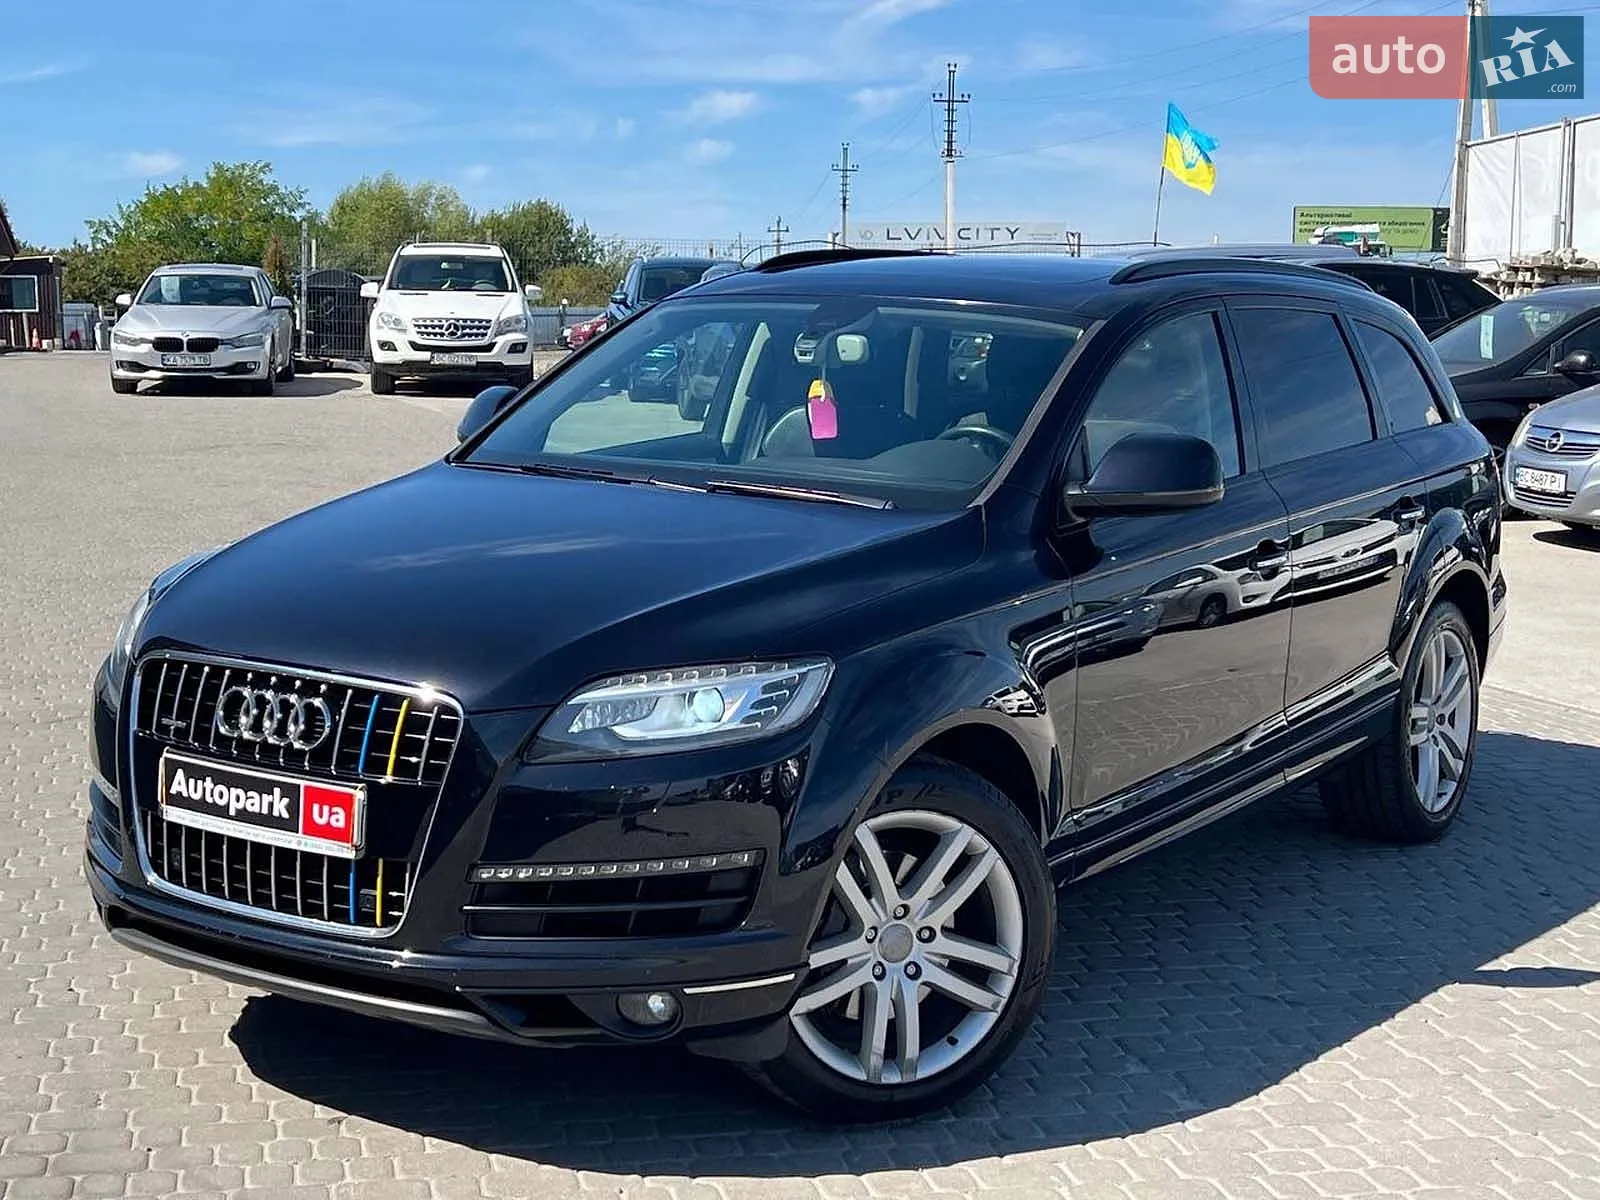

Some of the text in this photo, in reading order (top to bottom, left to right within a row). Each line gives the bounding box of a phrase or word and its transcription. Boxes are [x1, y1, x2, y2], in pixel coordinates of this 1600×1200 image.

[957, 227, 1021, 241] CITY
[169, 767, 290, 819] Autopark
[311, 802, 346, 829] ua
